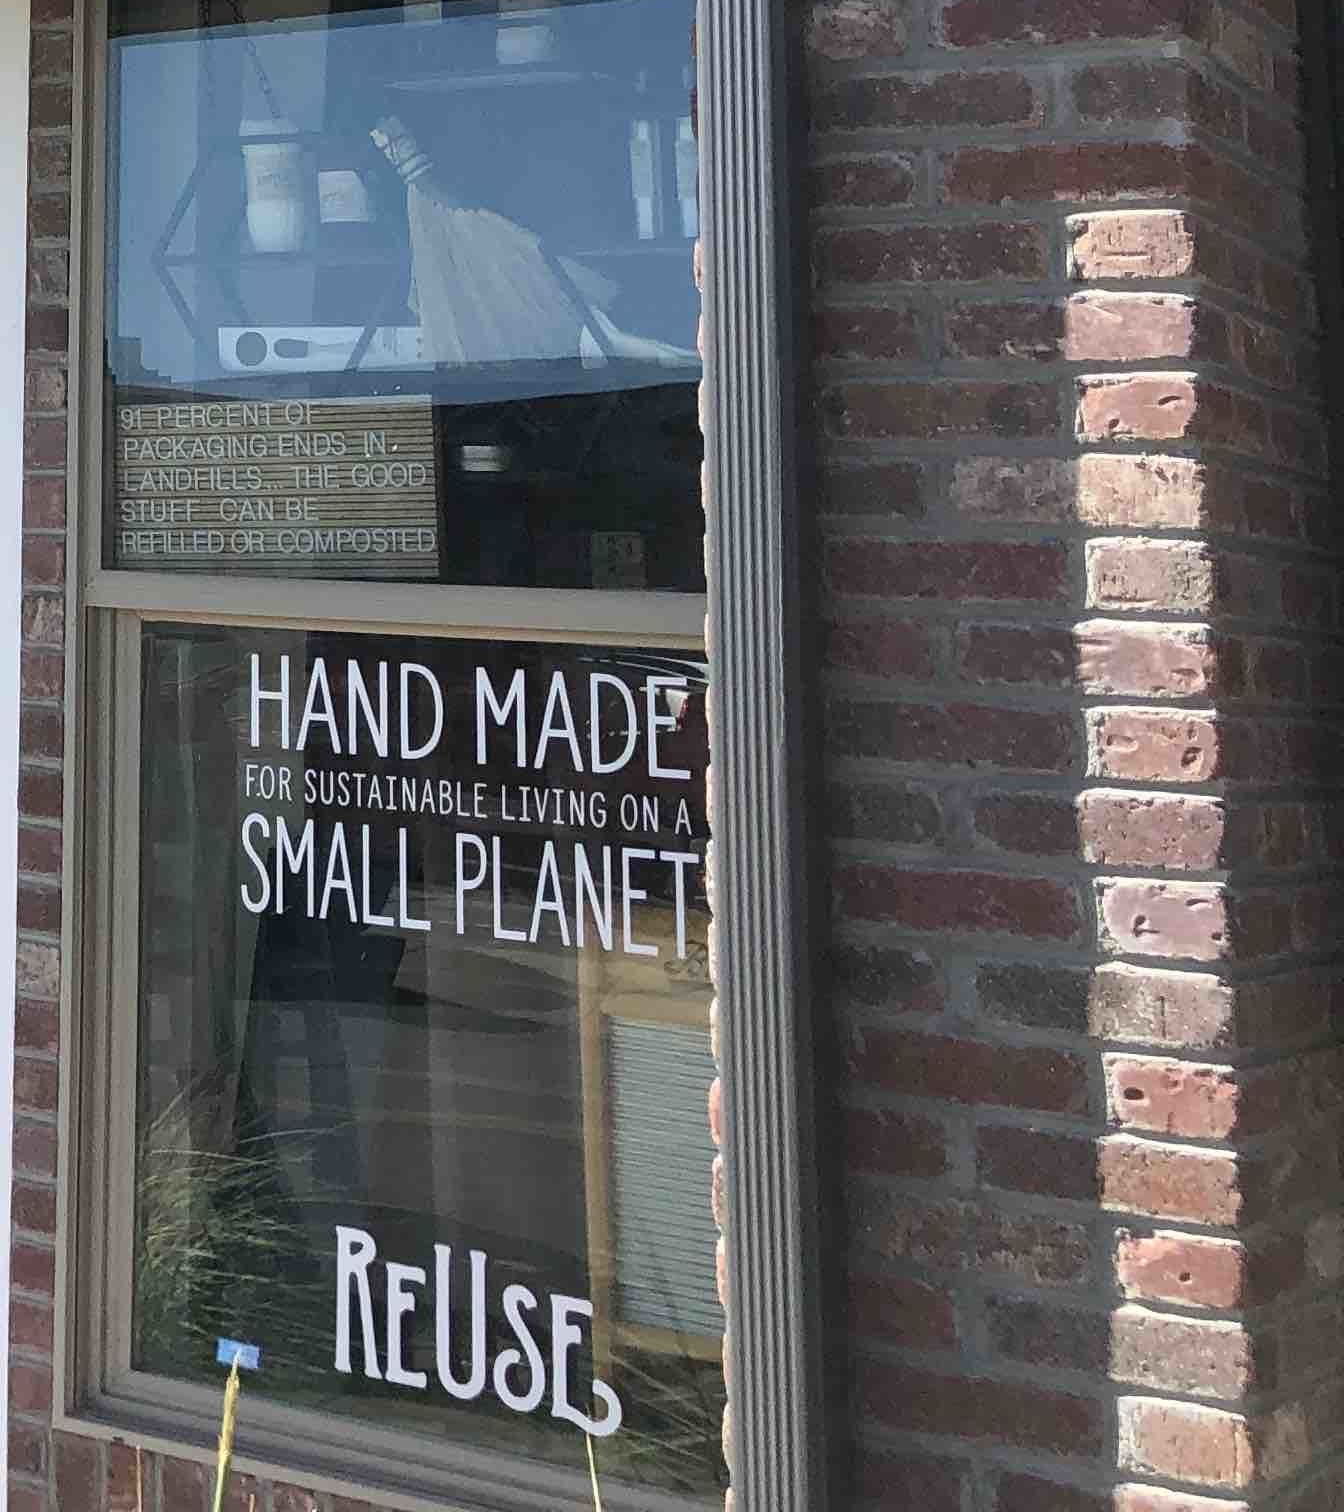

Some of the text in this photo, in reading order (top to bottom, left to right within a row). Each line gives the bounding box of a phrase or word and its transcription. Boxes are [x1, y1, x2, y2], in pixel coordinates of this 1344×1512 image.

[119, 401, 321, 431] 91 PERCENT OF
[123, 431, 386, 461] PACKAGING ENDS IN
[291, 464, 340, 489] THE
[351, 462, 427, 489] GOOD
[120, 497, 320, 523] STUFF CAN BE
[121, 527, 436, 554] REFILLED OR COMPOSTED
[249, 653, 692, 781] HAND MADE
[244, 764, 694, 837] FOR SUSTAINABLE LIVING ON A
[240, 812, 700, 960] SMALL PLANET
